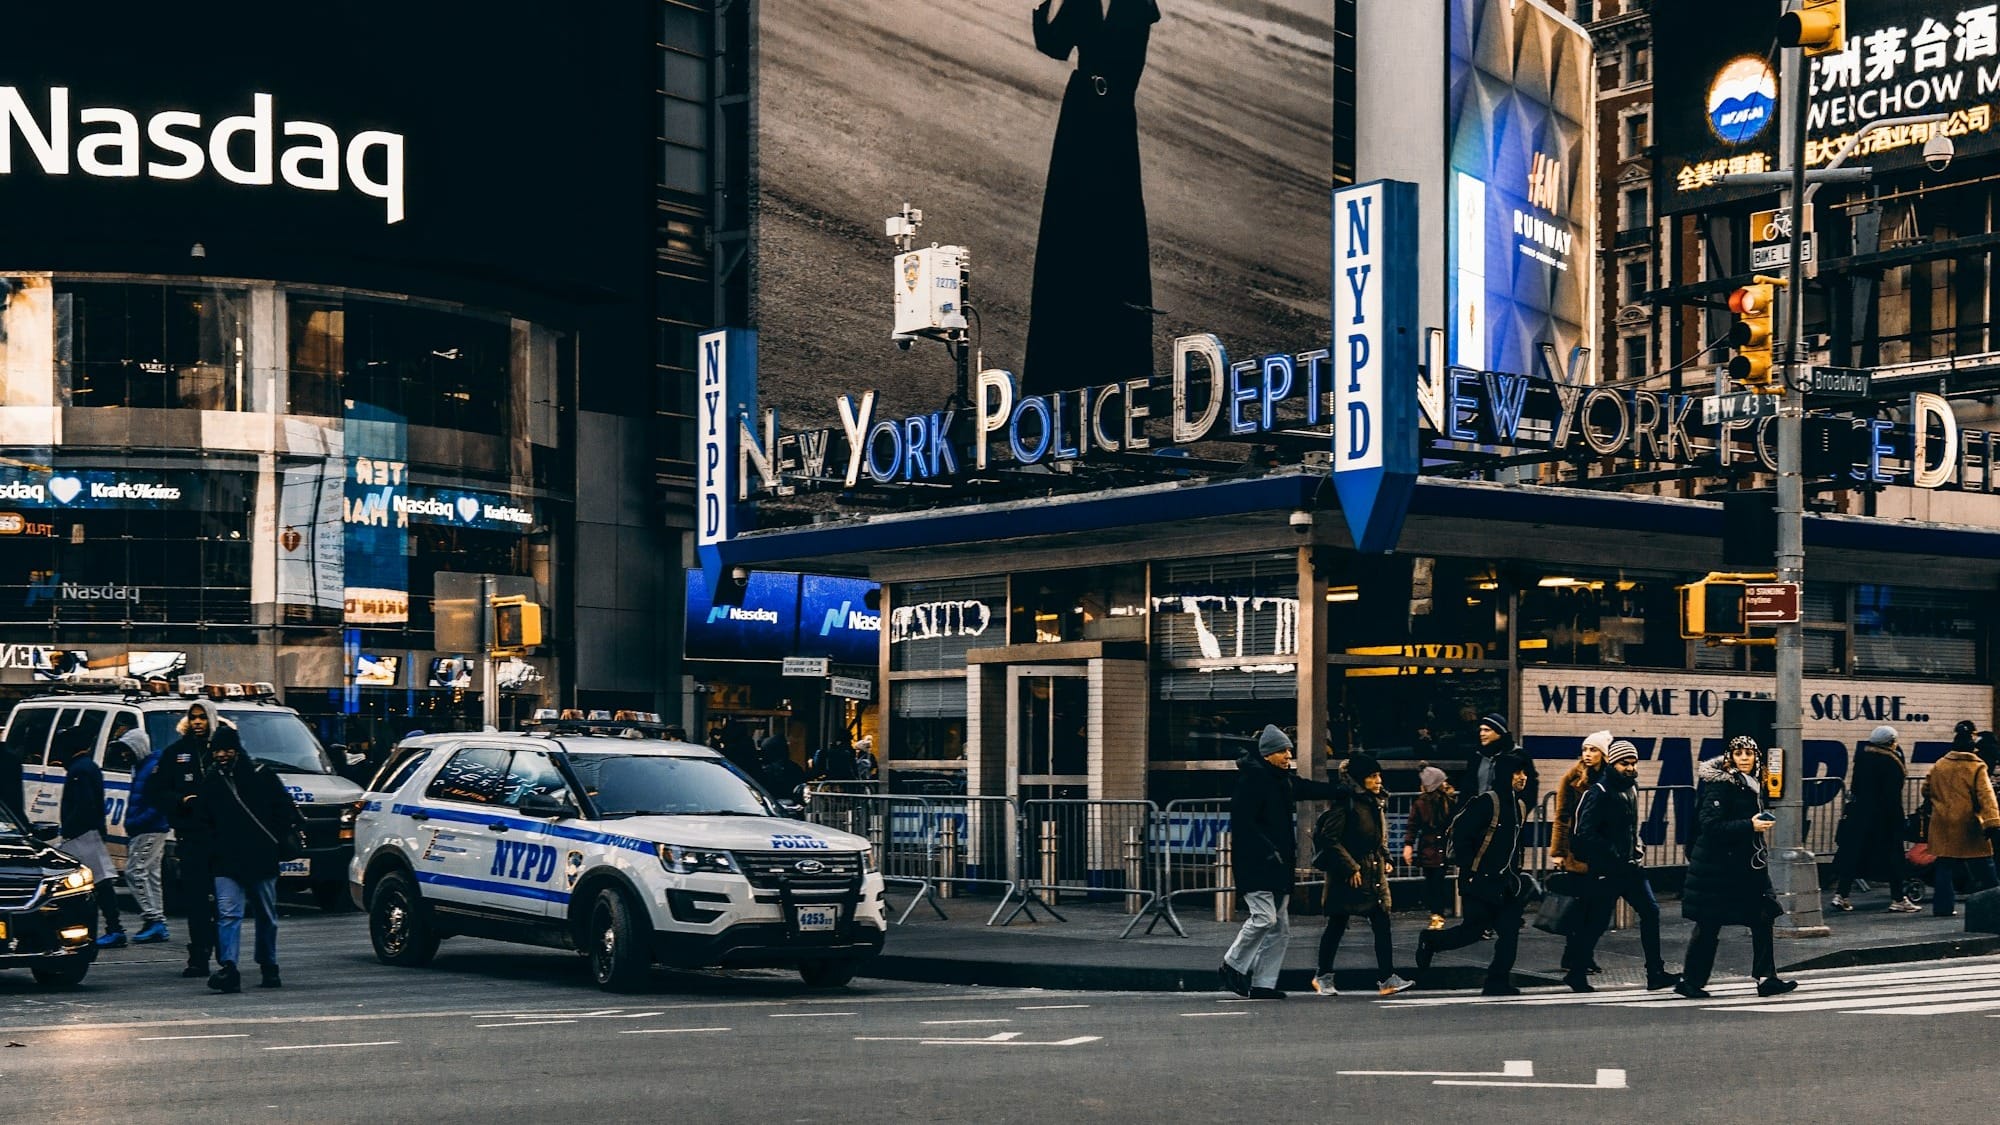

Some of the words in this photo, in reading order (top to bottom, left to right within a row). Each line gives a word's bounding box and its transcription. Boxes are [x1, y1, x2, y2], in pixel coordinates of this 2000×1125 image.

[0, 86, 404, 224] Nasdaq
[1528, 152, 1560, 216] H&M
[1513, 209, 1571, 255] RUNWAY
[1782, 242, 1809, 260] LE
[1346, 196, 1371, 460] NYPD
[1417, 328, 1529, 442] NEW
[1541, 342, 1697, 462] YORK
[1815, 371, 1869, 397] Broadway
[739, 404, 829, 500] NEW
[836, 390, 957, 488] YORK
[976, 350, 1150, 471] POLICE
[1172, 333, 1329, 444] DEPT
[1721, 398, 1736, 418] W
[1742, 394, 1760, 415] 43
[705, 340, 720, 537] NYPD
[392, 495, 455, 521] Nasdaq
[62, 582, 140, 604] Nasdaq
[730, 607, 778, 624] Nasdaq
[1538, 685, 1679, 716] WELCOME
[1684, 687, 1719, 717] TO
[607, 834, 641, 851] POLICE
[771, 840, 829, 849] POLICE
[490, 839, 558, 883] NYPD
